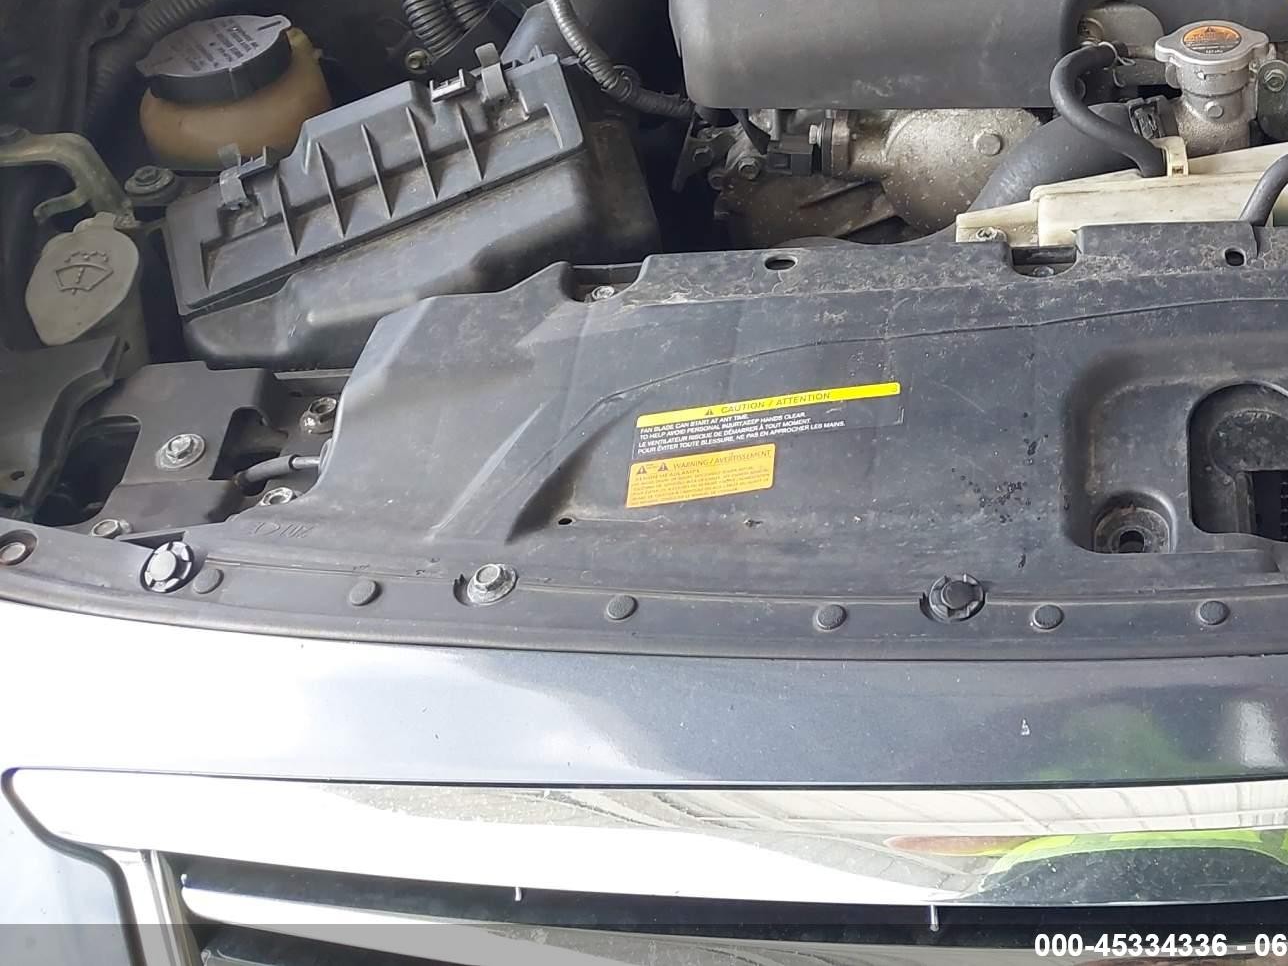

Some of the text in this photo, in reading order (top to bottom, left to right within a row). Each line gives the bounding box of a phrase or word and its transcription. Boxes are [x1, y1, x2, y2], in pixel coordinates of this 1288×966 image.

[720, 401, 766, 414] CAUTION
[776, 392, 831, 407] ATTENTION
[640, 426, 654, 434] FAN
[654, 424, 674, 432] BLADE
[675, 421, 690, 429] CAN
[690, 419, 710, 427] START
[720, 415, 734, 423] ANY
[647, 435, 688, 447] VENTILATEUR
[688, 431, 713, 441] RISQUE
[713, 429, 723, 437] DE
[723, 424, 759, 436] DÉMARRER
[765, 420, 782, 429] TOUT
[649, 431, 666, 440] HELP
[666, 428, 686, 438] AVOID
[686, 424, 721, 435] PERSONAL
[760, 414, 782, 424] HANDS
[638, 445, 657, 454] POUR
[657, 442, 679, 452] ÉVITER
[679, 439, 700, 449] TOUTE
[746, 432, 759, 440] PAS
[769, 424, 809, 436] APPROCHER
[810, 422, 823, 430] LES
